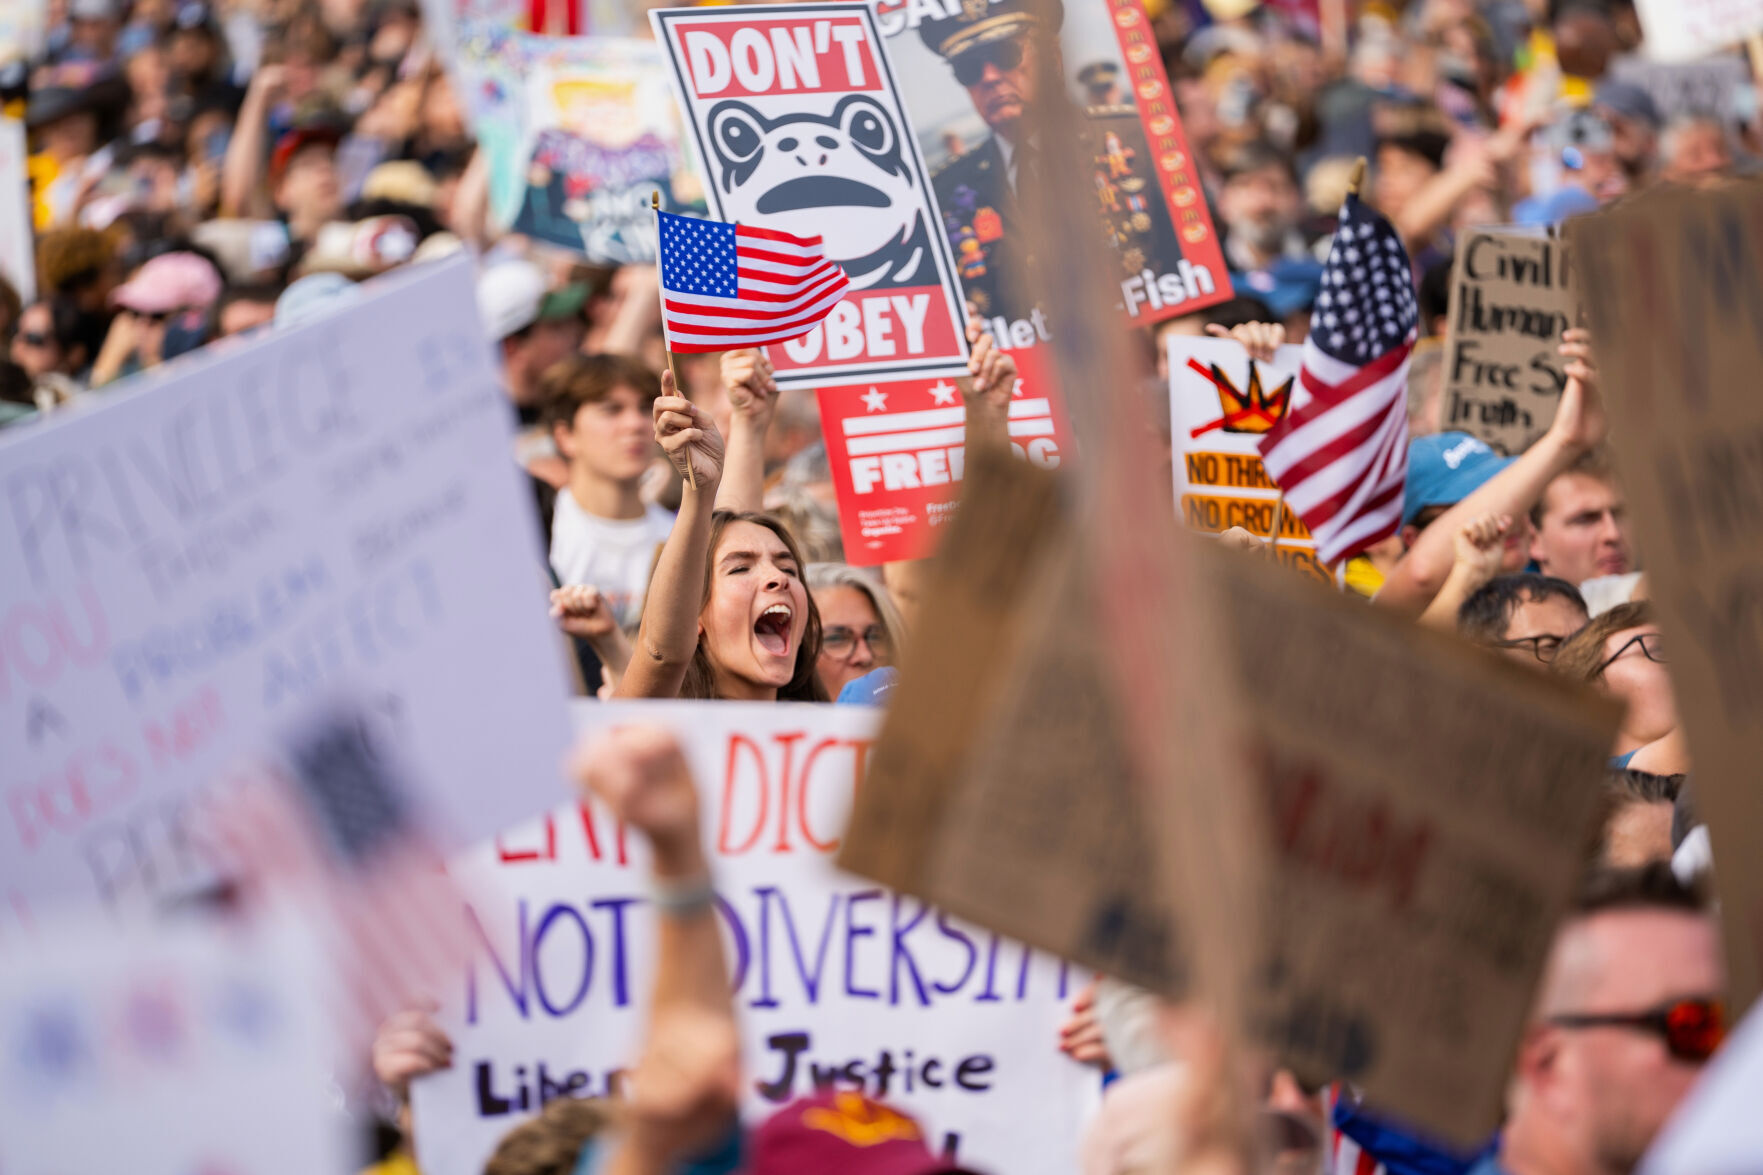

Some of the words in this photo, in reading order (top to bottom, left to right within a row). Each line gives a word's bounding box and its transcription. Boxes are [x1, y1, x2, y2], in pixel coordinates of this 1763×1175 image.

[685, 20, 867, 94] DON'T
[1465, 234, 1552, 288] Civil
[1453, 341, 1521, 389] Free
[1187, 455, 1219, 484] NO
[1187, 497, 1220, 529] NO
[463, 896, 645, 1026] NOT
[754, 1031, 996, 1104] Justice
